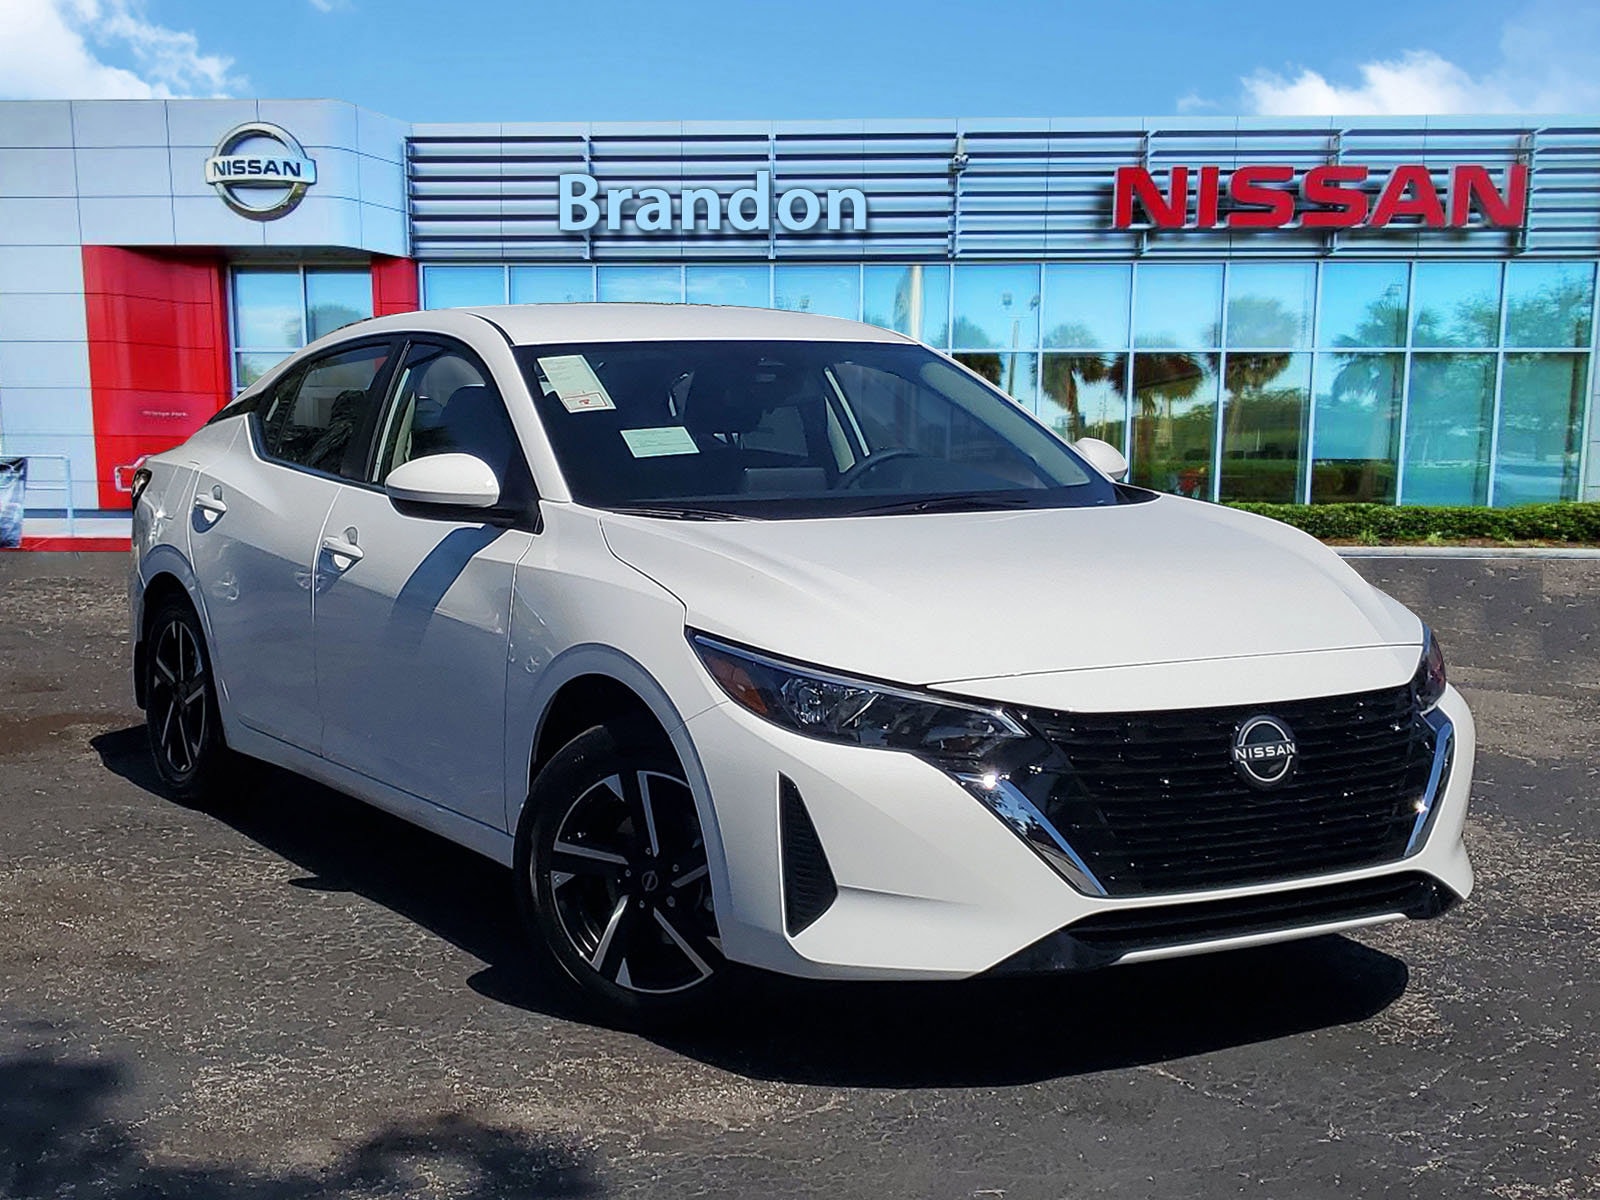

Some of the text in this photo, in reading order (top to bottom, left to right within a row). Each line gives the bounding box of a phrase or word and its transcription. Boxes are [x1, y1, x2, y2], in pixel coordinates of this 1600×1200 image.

[213, 160, 301, 177] NISSAN
[559, 170, 867, 231] Brandon
[1112, 165, 1528, 229] NISSAN
[1234, 743, 1296, 760] NISSAN
